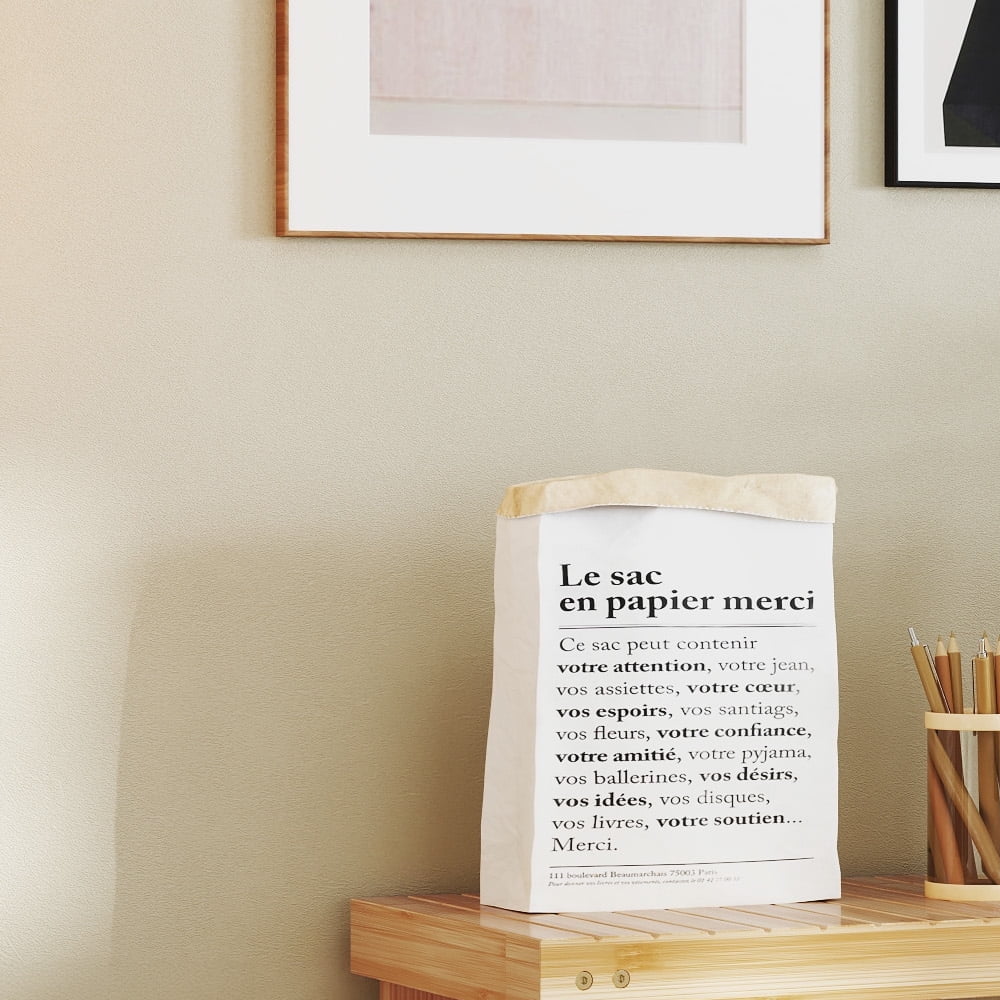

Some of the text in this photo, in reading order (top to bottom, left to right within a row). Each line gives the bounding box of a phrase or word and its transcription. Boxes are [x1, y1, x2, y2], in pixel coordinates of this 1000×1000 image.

[559, 563, 663, 587] Le sac
[559, 589, 815, 620] en papier merci
[559, 636, 759, 656] Ce sac peut contenir
[556, 657, 815, 676] votre attention, votre jean,
[555, 681, 800, 697] vos assiettes, votre cœur,
[555, 701, 799, 723] vos espoirs, vos santiags,
[555, 722, 812, 743] vos fleurs, votre confiance,
[555, 745, 812, 764] votre amitié, votre pyjama,
[554, 766, 798, 786] vos ballerines, vos désirs,
[552, 789, 771, 809] vos idées, vos disques,
[551, 811, 803, 831] vos livres, votre soutien...
[551, 837, 618, 852] Merci.
[566, 871, 608, 879] boulevard
